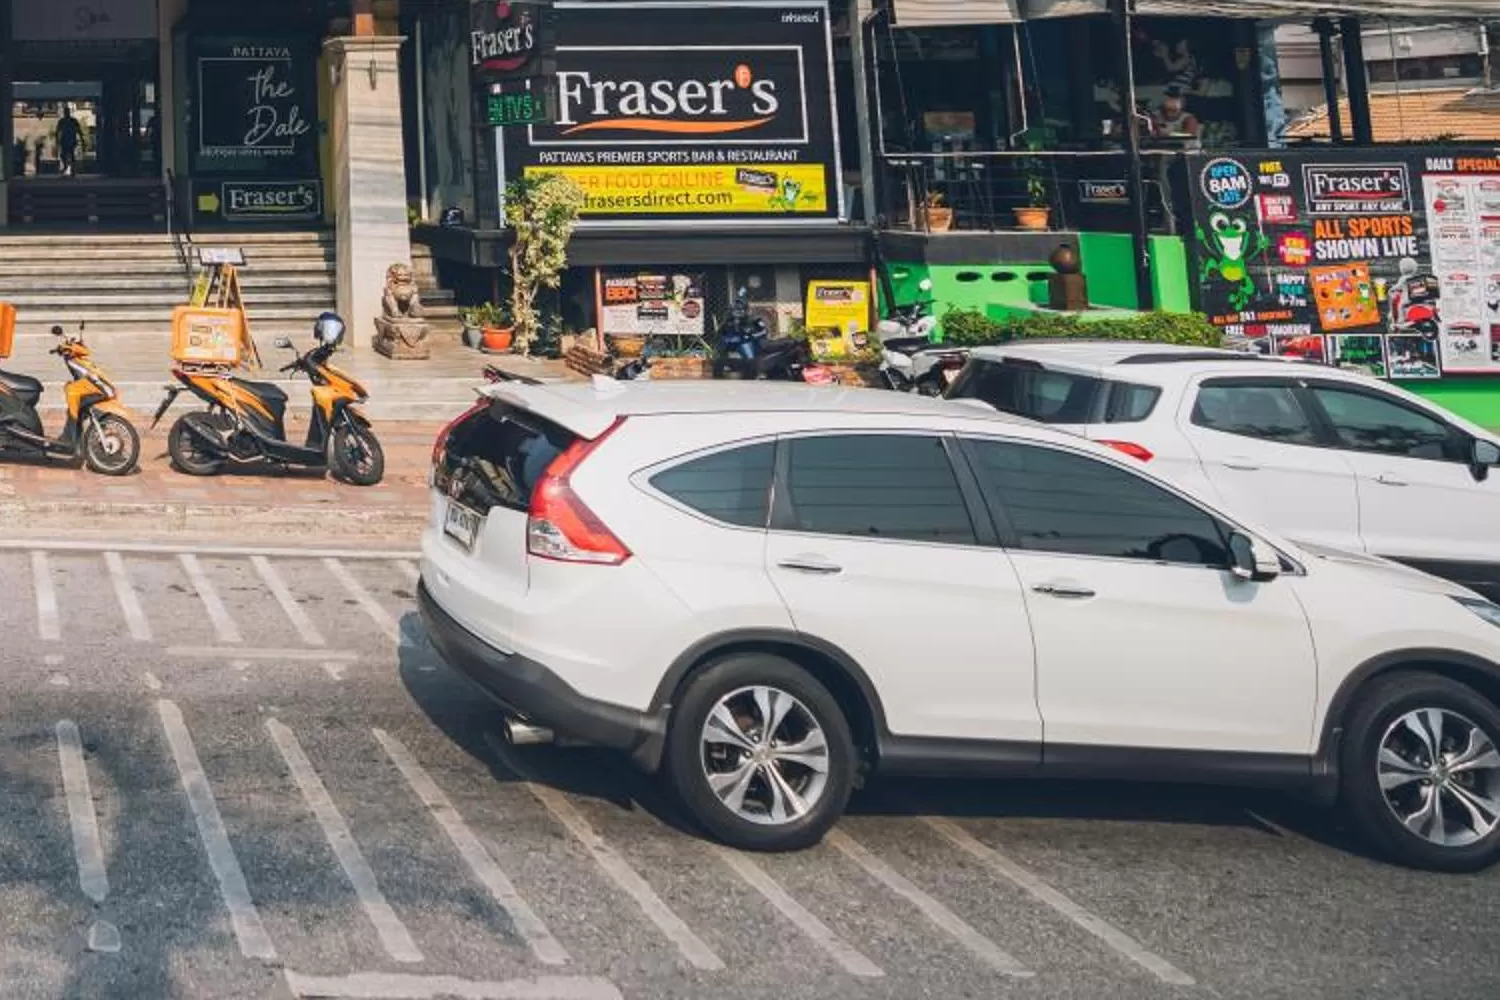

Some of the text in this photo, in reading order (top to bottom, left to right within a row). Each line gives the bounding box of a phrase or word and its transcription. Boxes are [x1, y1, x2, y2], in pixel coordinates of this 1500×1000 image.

[232, 46, 291, 58] PATTAYA
[470, 20, 534, 65] Fraser's
[247, 65, 296, 105] the
[553, 64, 780, 126] Fraser's
[243, 105, 311, 147] Dale
[538, 150, 799, 163] PATTAYA'S PREMIER SPORTS BAR & RESTAURANT
[1425, 157, 1453, 171] DAILY
[605, 173, 654, 189] FOOD
[658, 171, 725, 188] ONLINE
[1209, 175, 1247, 193] 8AM
[1312, 171, 1401, 197] Fraser's
[229, 186, 314, 209] Fraser's
[579, 190, 733, 209] .frasersdirect.com
[1315, 219, 1344, 239] ALL
[1347, 216, 1413, 238] SPORTS
[1315, 238, 1380, 260] SHOWN
[1382, 236, 1419, 257] LIVE
[605, 287, 637, 301] BBQ
